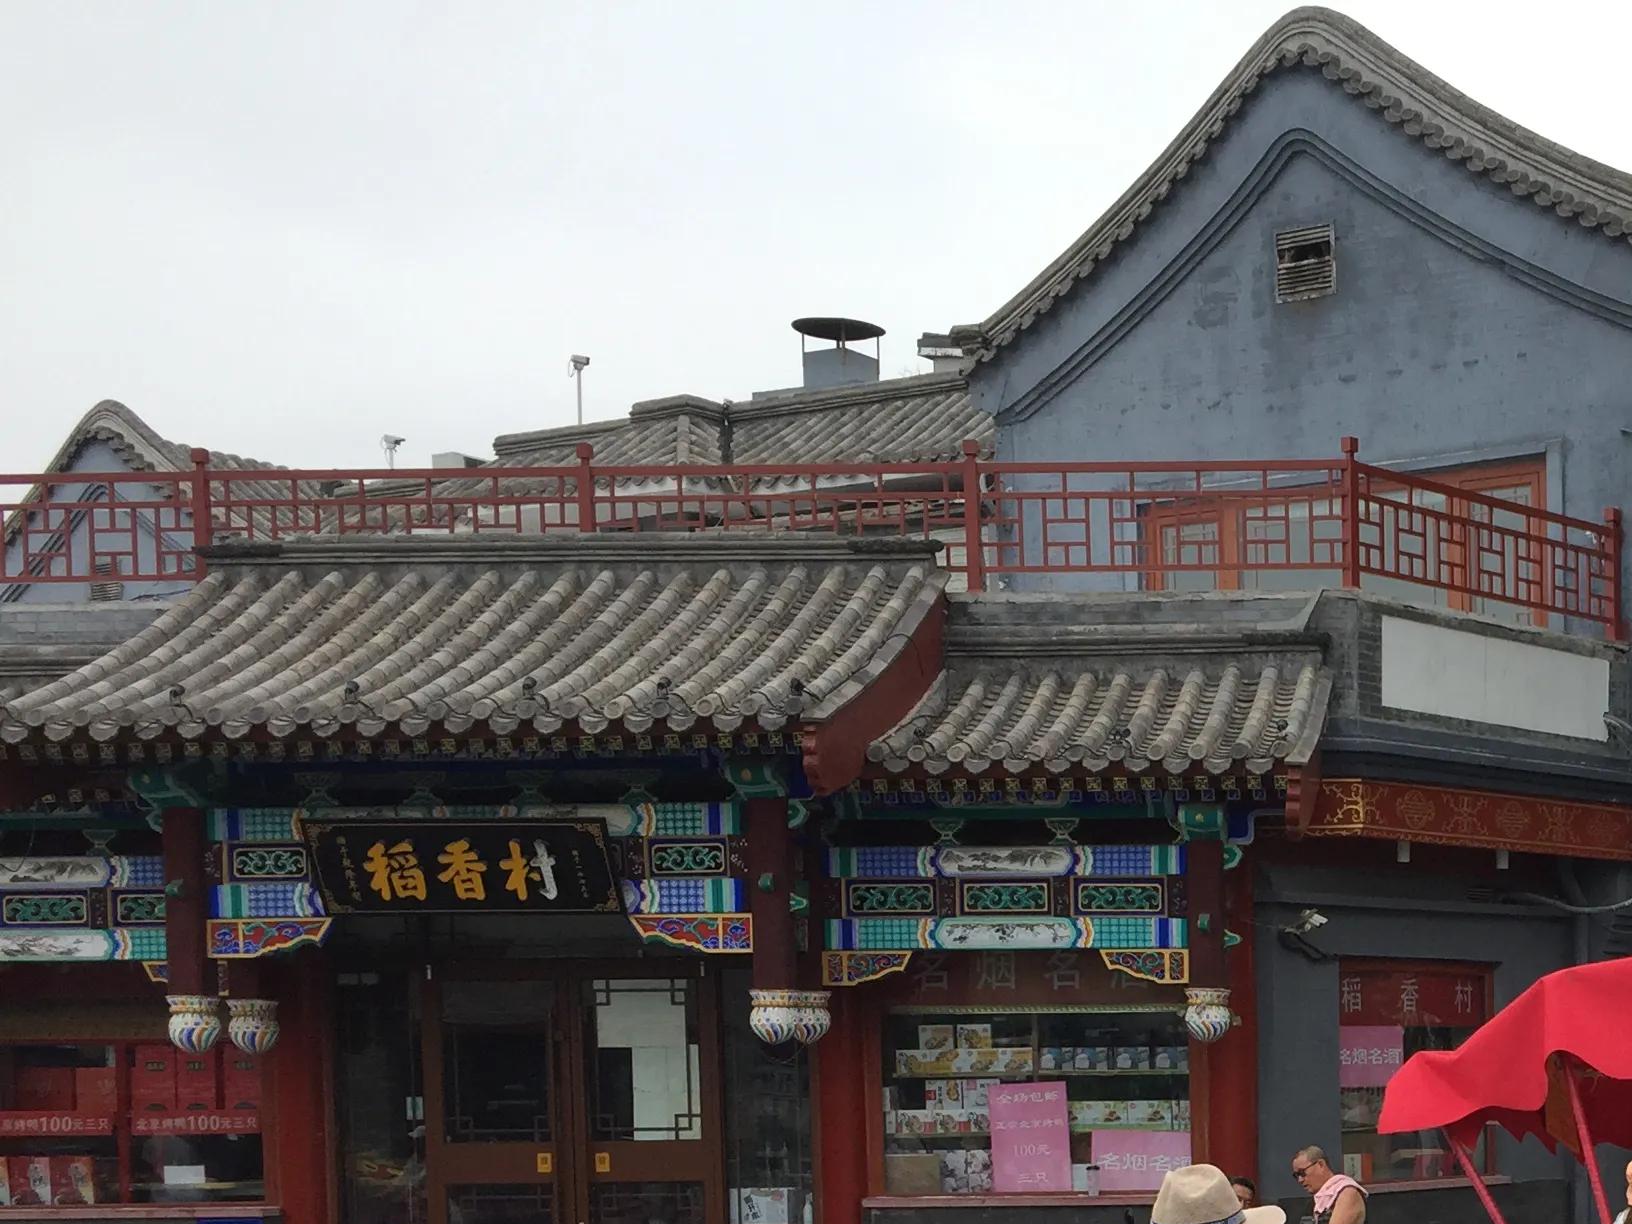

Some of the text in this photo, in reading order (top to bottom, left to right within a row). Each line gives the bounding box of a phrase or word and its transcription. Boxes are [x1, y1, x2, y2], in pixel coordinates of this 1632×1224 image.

[363, 837, 558, 901] 稻香村
[1341, 977, 1473, 1014] 稻香村
[1340, 1048, 1402, 1065] 名烟名酒
[1017, 1172, 1048, 1183] 三只
